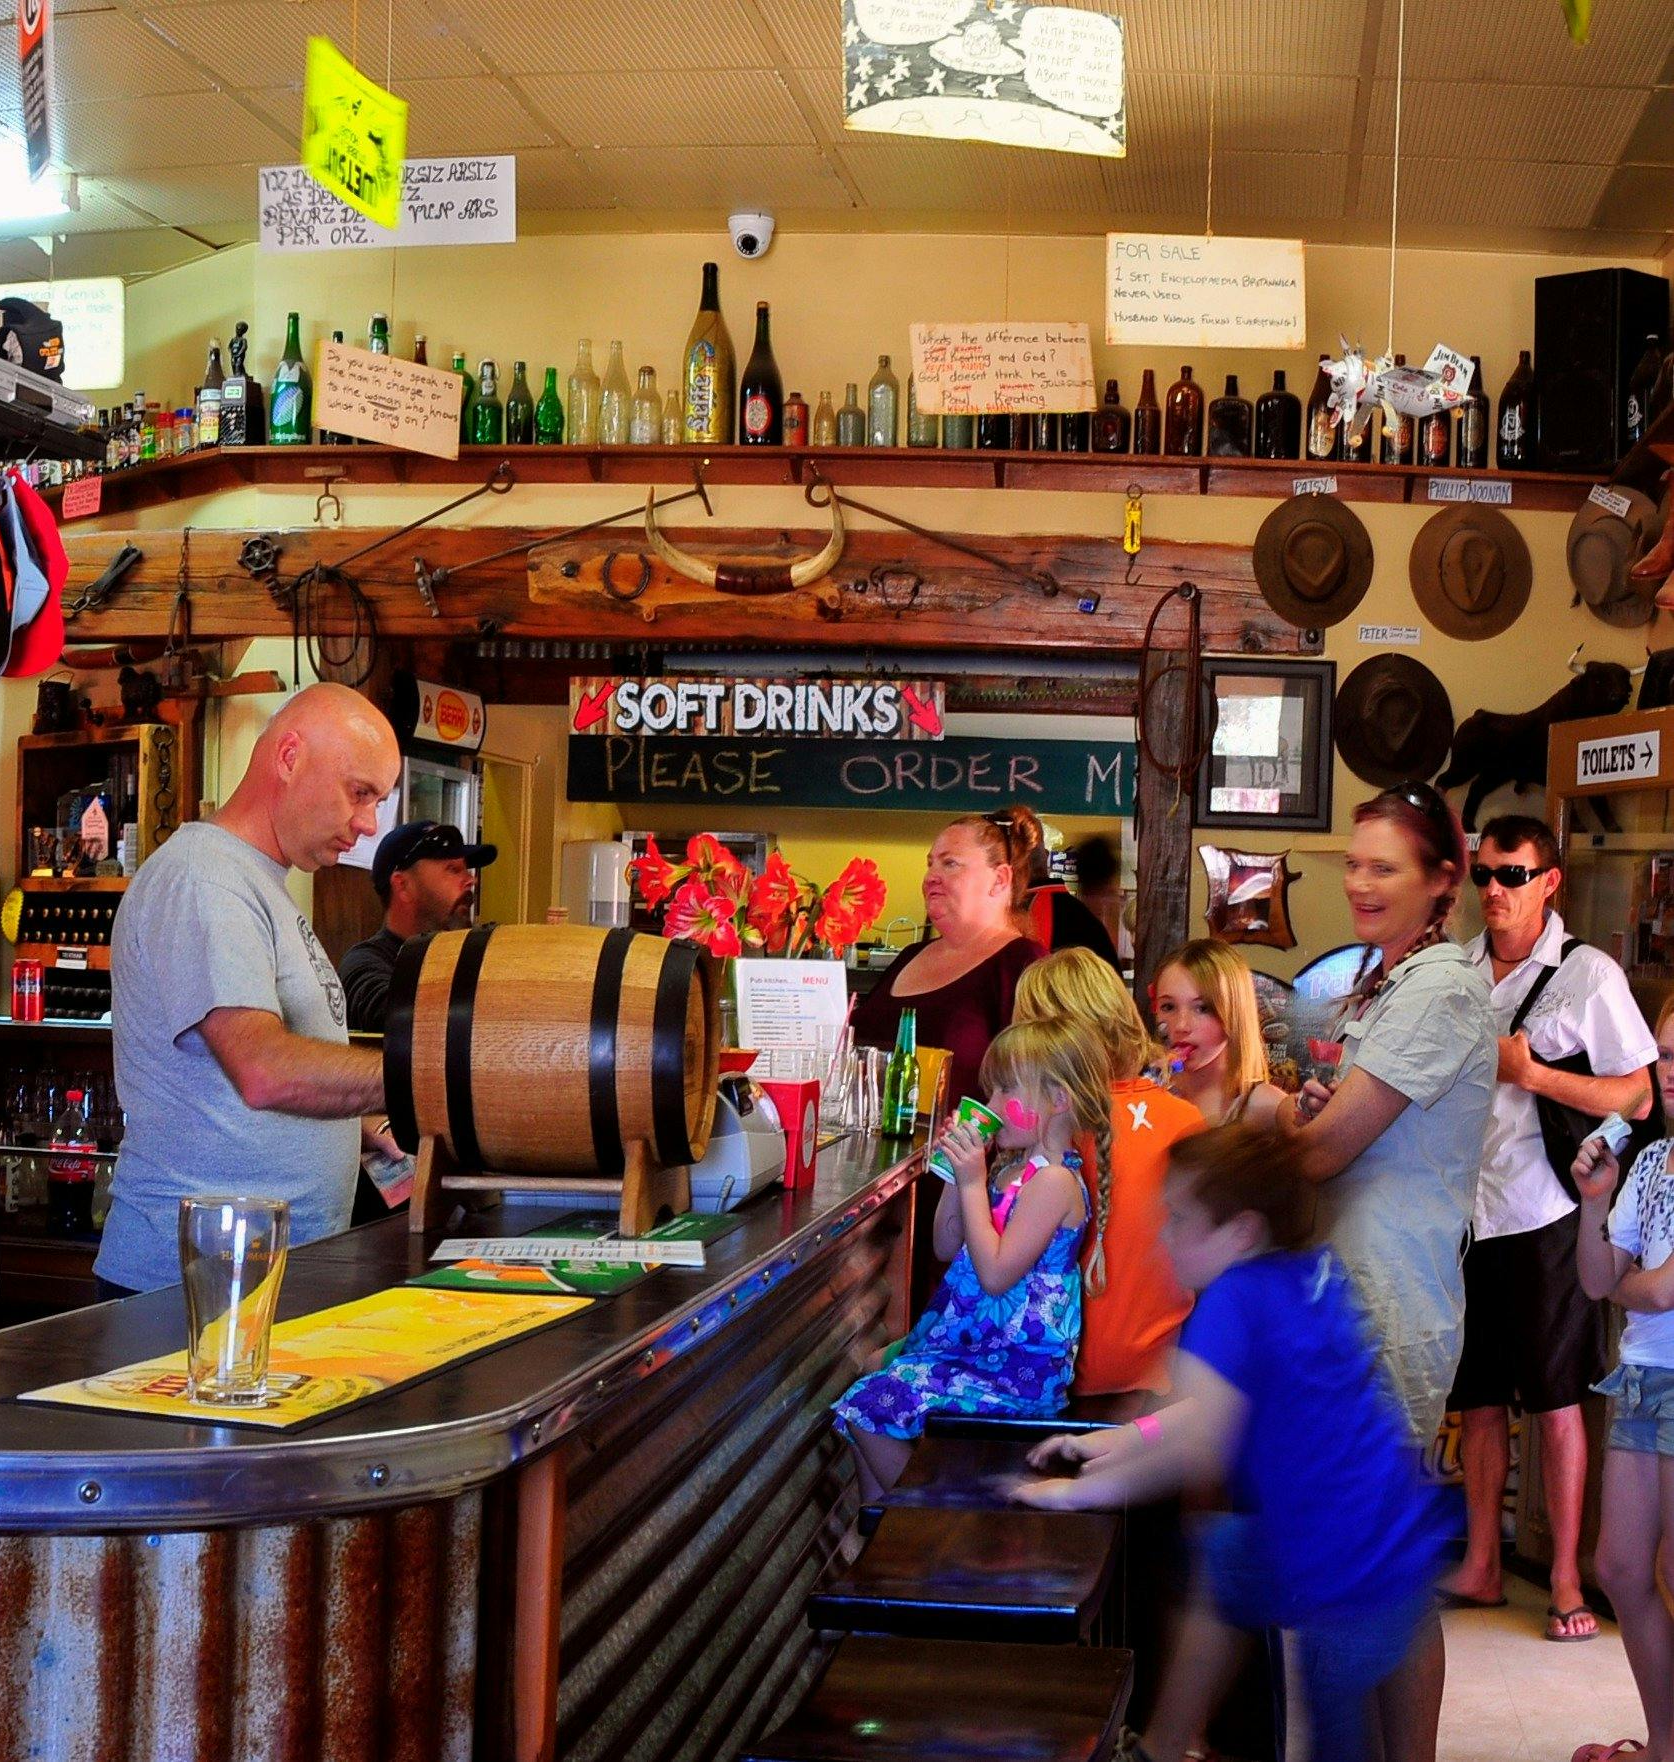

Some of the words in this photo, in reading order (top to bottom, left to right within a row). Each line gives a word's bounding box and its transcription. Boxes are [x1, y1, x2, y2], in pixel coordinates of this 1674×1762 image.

[1115, 241, 1150, 261] FOR
[1160, 244, 1201, 261] SALE
[1294, 479, 1333, 494] PATSY
[1358, 627, 1388, 641] PETER
[614, 682, 724, 733] SOFT
[732, 683, 899, 733] DRINKS
[605, 736, 784, 795] PLEASE
[840, 753, 1044, 795] ORDER
[1581, 743, 1636, 776] TOILETS
[801, 976, 829, 985] MENU
